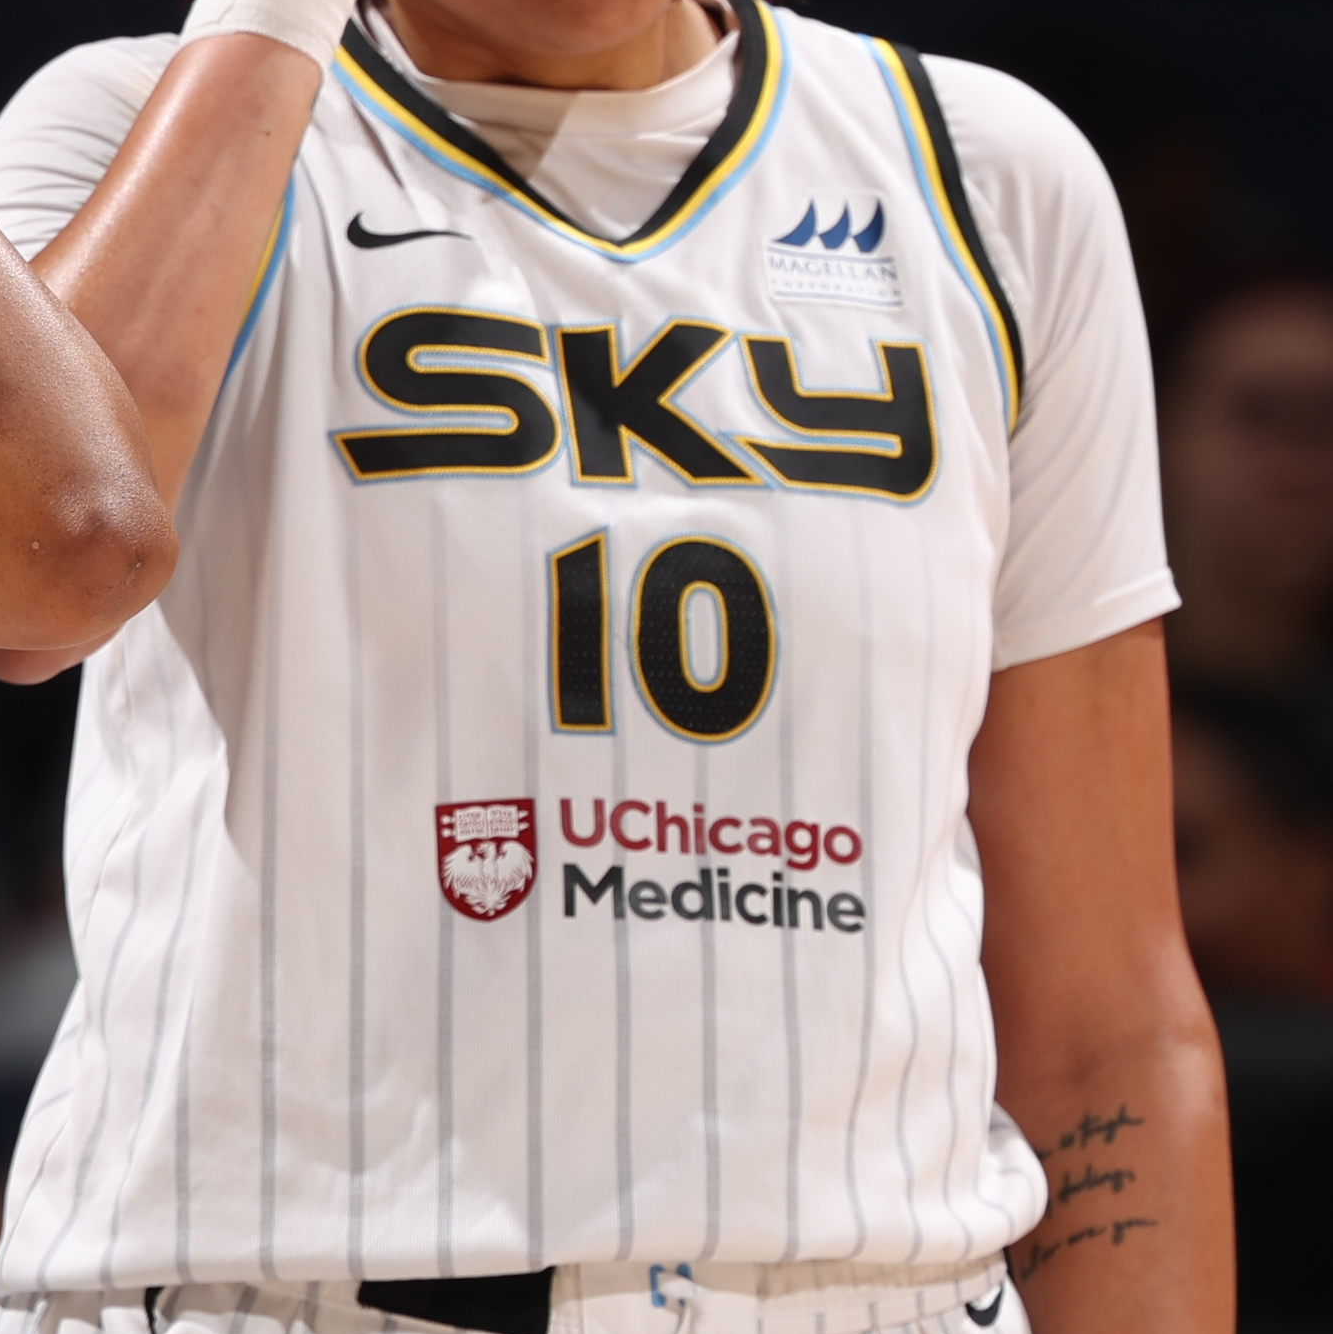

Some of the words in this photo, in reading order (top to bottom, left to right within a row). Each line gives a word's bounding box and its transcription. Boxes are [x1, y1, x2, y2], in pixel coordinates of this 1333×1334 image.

[328, 303, 943, 507] SKY
[545, 525, 781, 744] 10
[559, 797, 864, 872] UChicago
[563, 863, 866, 934] Medicine
